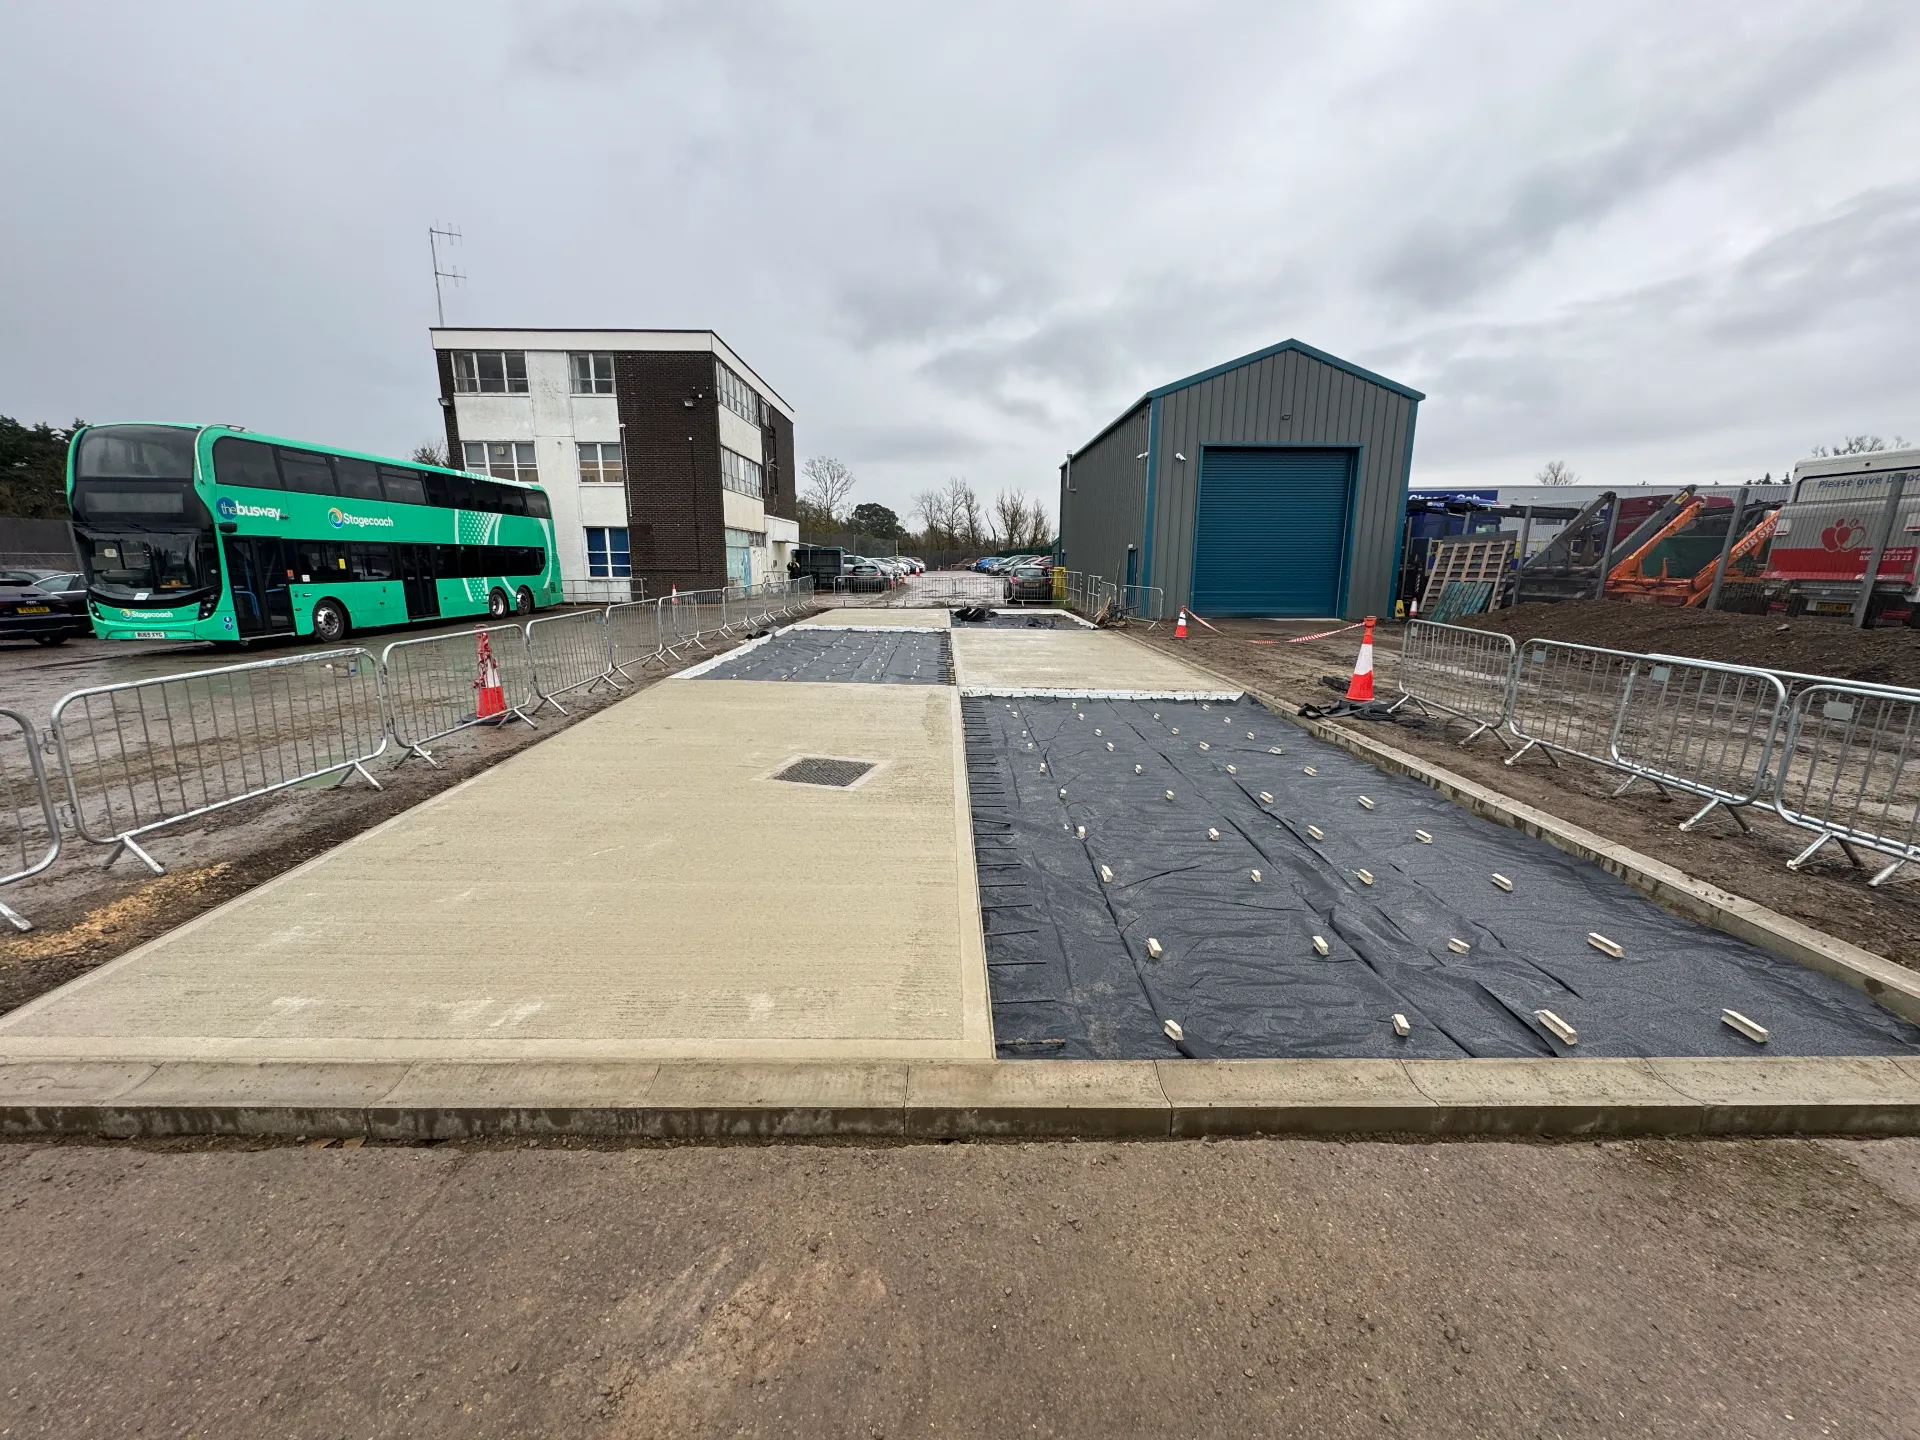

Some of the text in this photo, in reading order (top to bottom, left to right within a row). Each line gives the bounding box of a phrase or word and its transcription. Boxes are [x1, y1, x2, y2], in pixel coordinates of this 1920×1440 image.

[1818, 479, 1853, 489] Please
[1857, 476, 1882, 487] give
[343, 513, 394, 528] Stagecoach
[1736, 535, 1759, 557] SUN
[131, 610, 174, 619] Stagecoach
